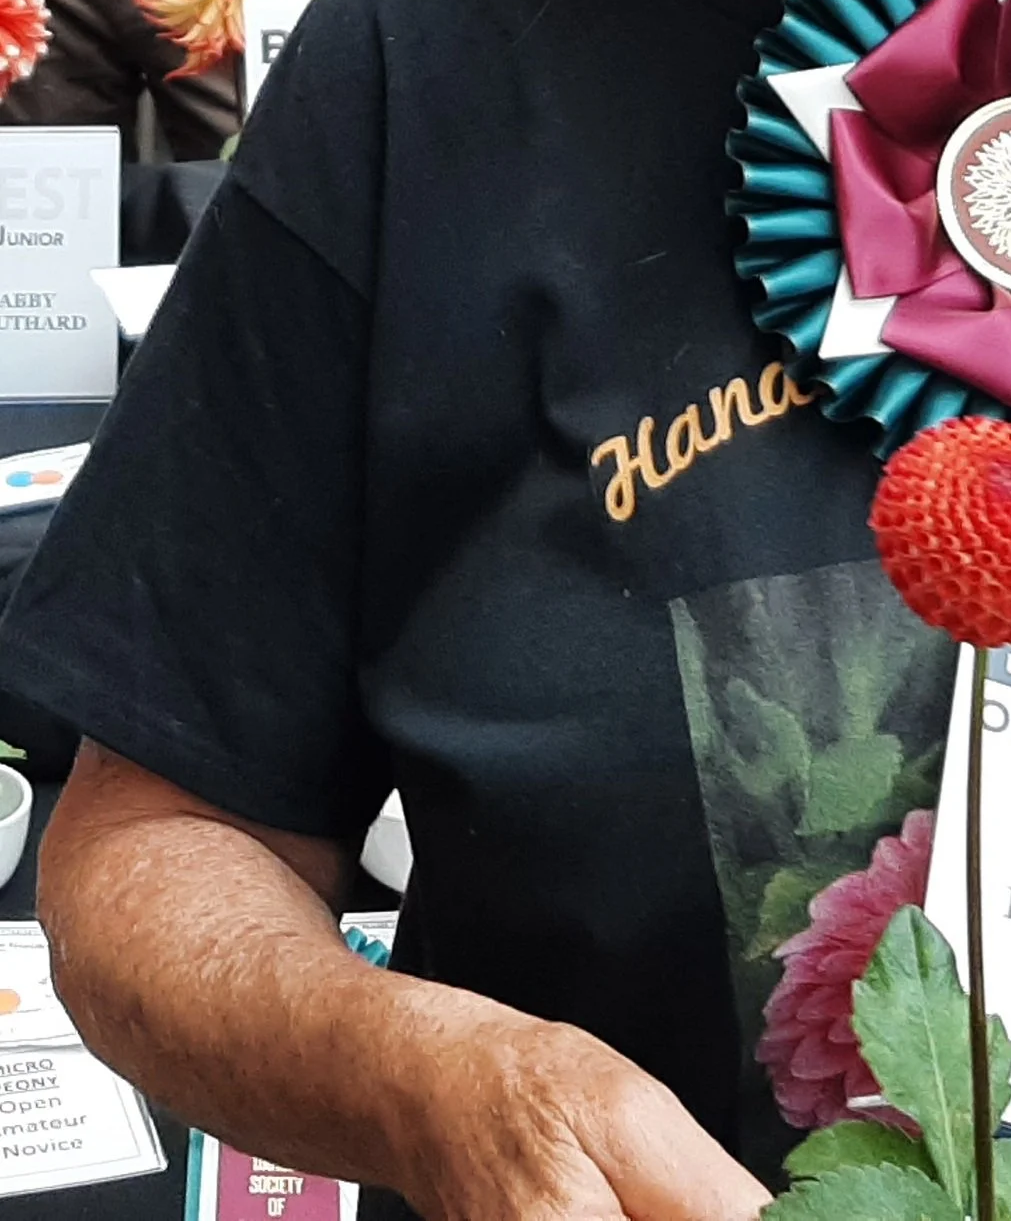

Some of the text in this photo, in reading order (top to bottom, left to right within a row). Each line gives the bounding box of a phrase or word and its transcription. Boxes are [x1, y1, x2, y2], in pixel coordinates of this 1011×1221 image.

[0, 1076, 58, 1093] EONY
[0, 1097, 62, 1115] Open
[0, 1114, 87, 1138] mateur
[3, 1138, 83, 1159] Novice
[267, 1197, 286, 1217] OF
